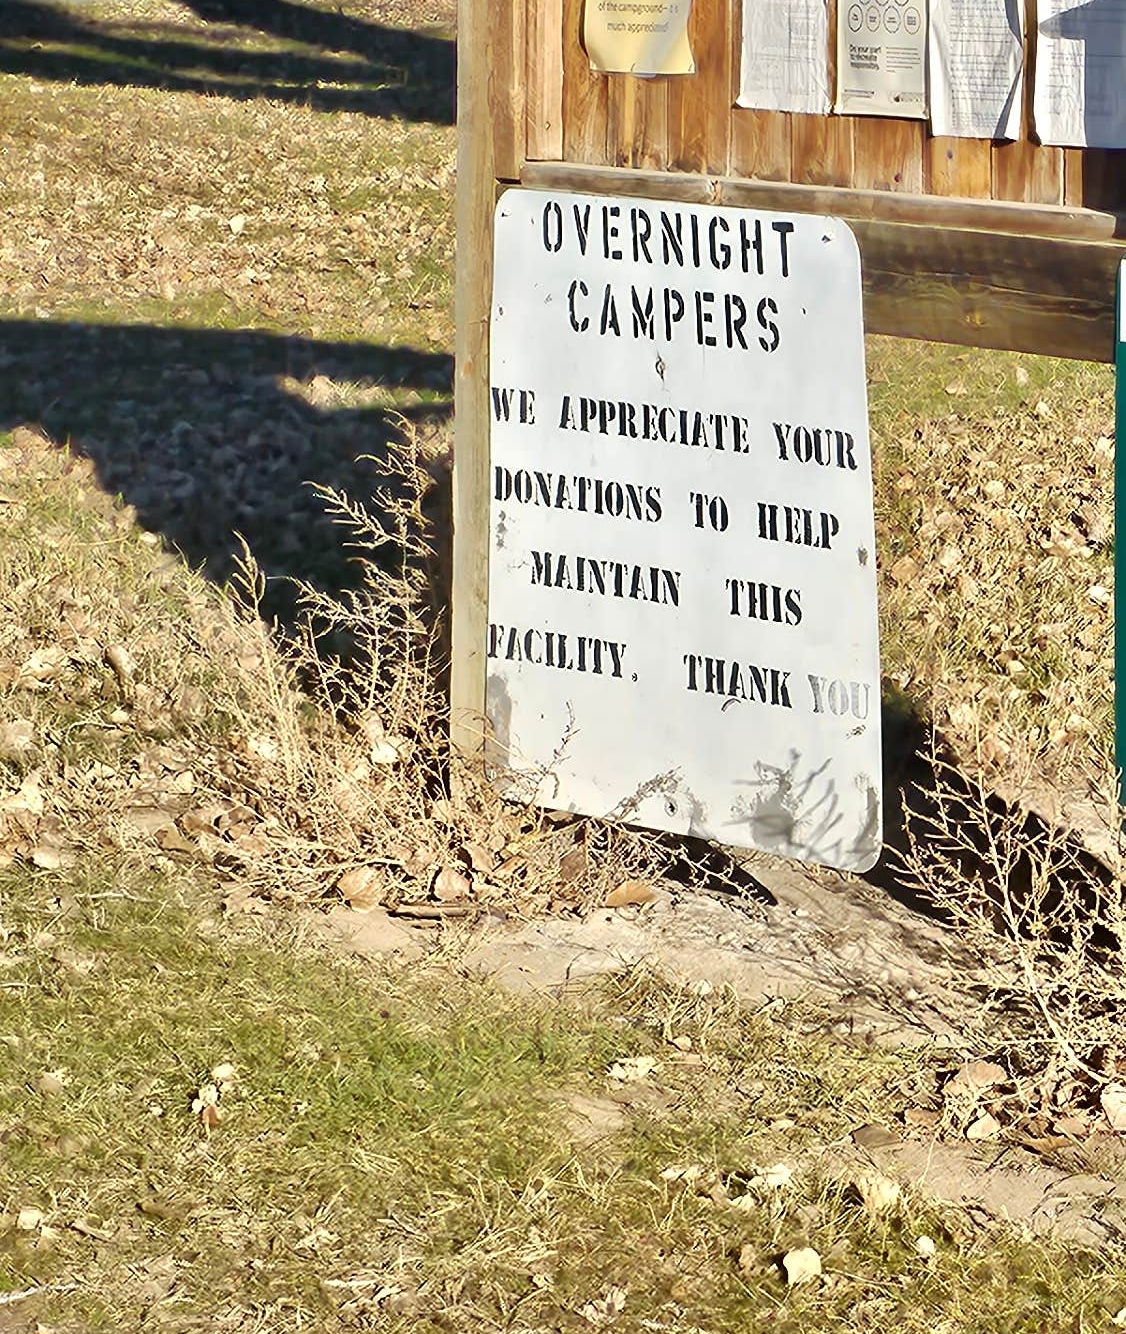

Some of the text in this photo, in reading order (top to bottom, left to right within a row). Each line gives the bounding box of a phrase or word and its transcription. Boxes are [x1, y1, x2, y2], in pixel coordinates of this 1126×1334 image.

[542, 200, 795, 278] OVERNIGHT
[567, 279, 782, 353] CAMPERS
[491, 387, 858, 471] WE APPRECIATE YOUR
[494, 466, 840, 550] DONATIONS TO HELP
[530, 551, 803, 627] MAINTAIN THIS
[684, 654, 792, 710] THANK
[807, 673, 871, 720] YOU
